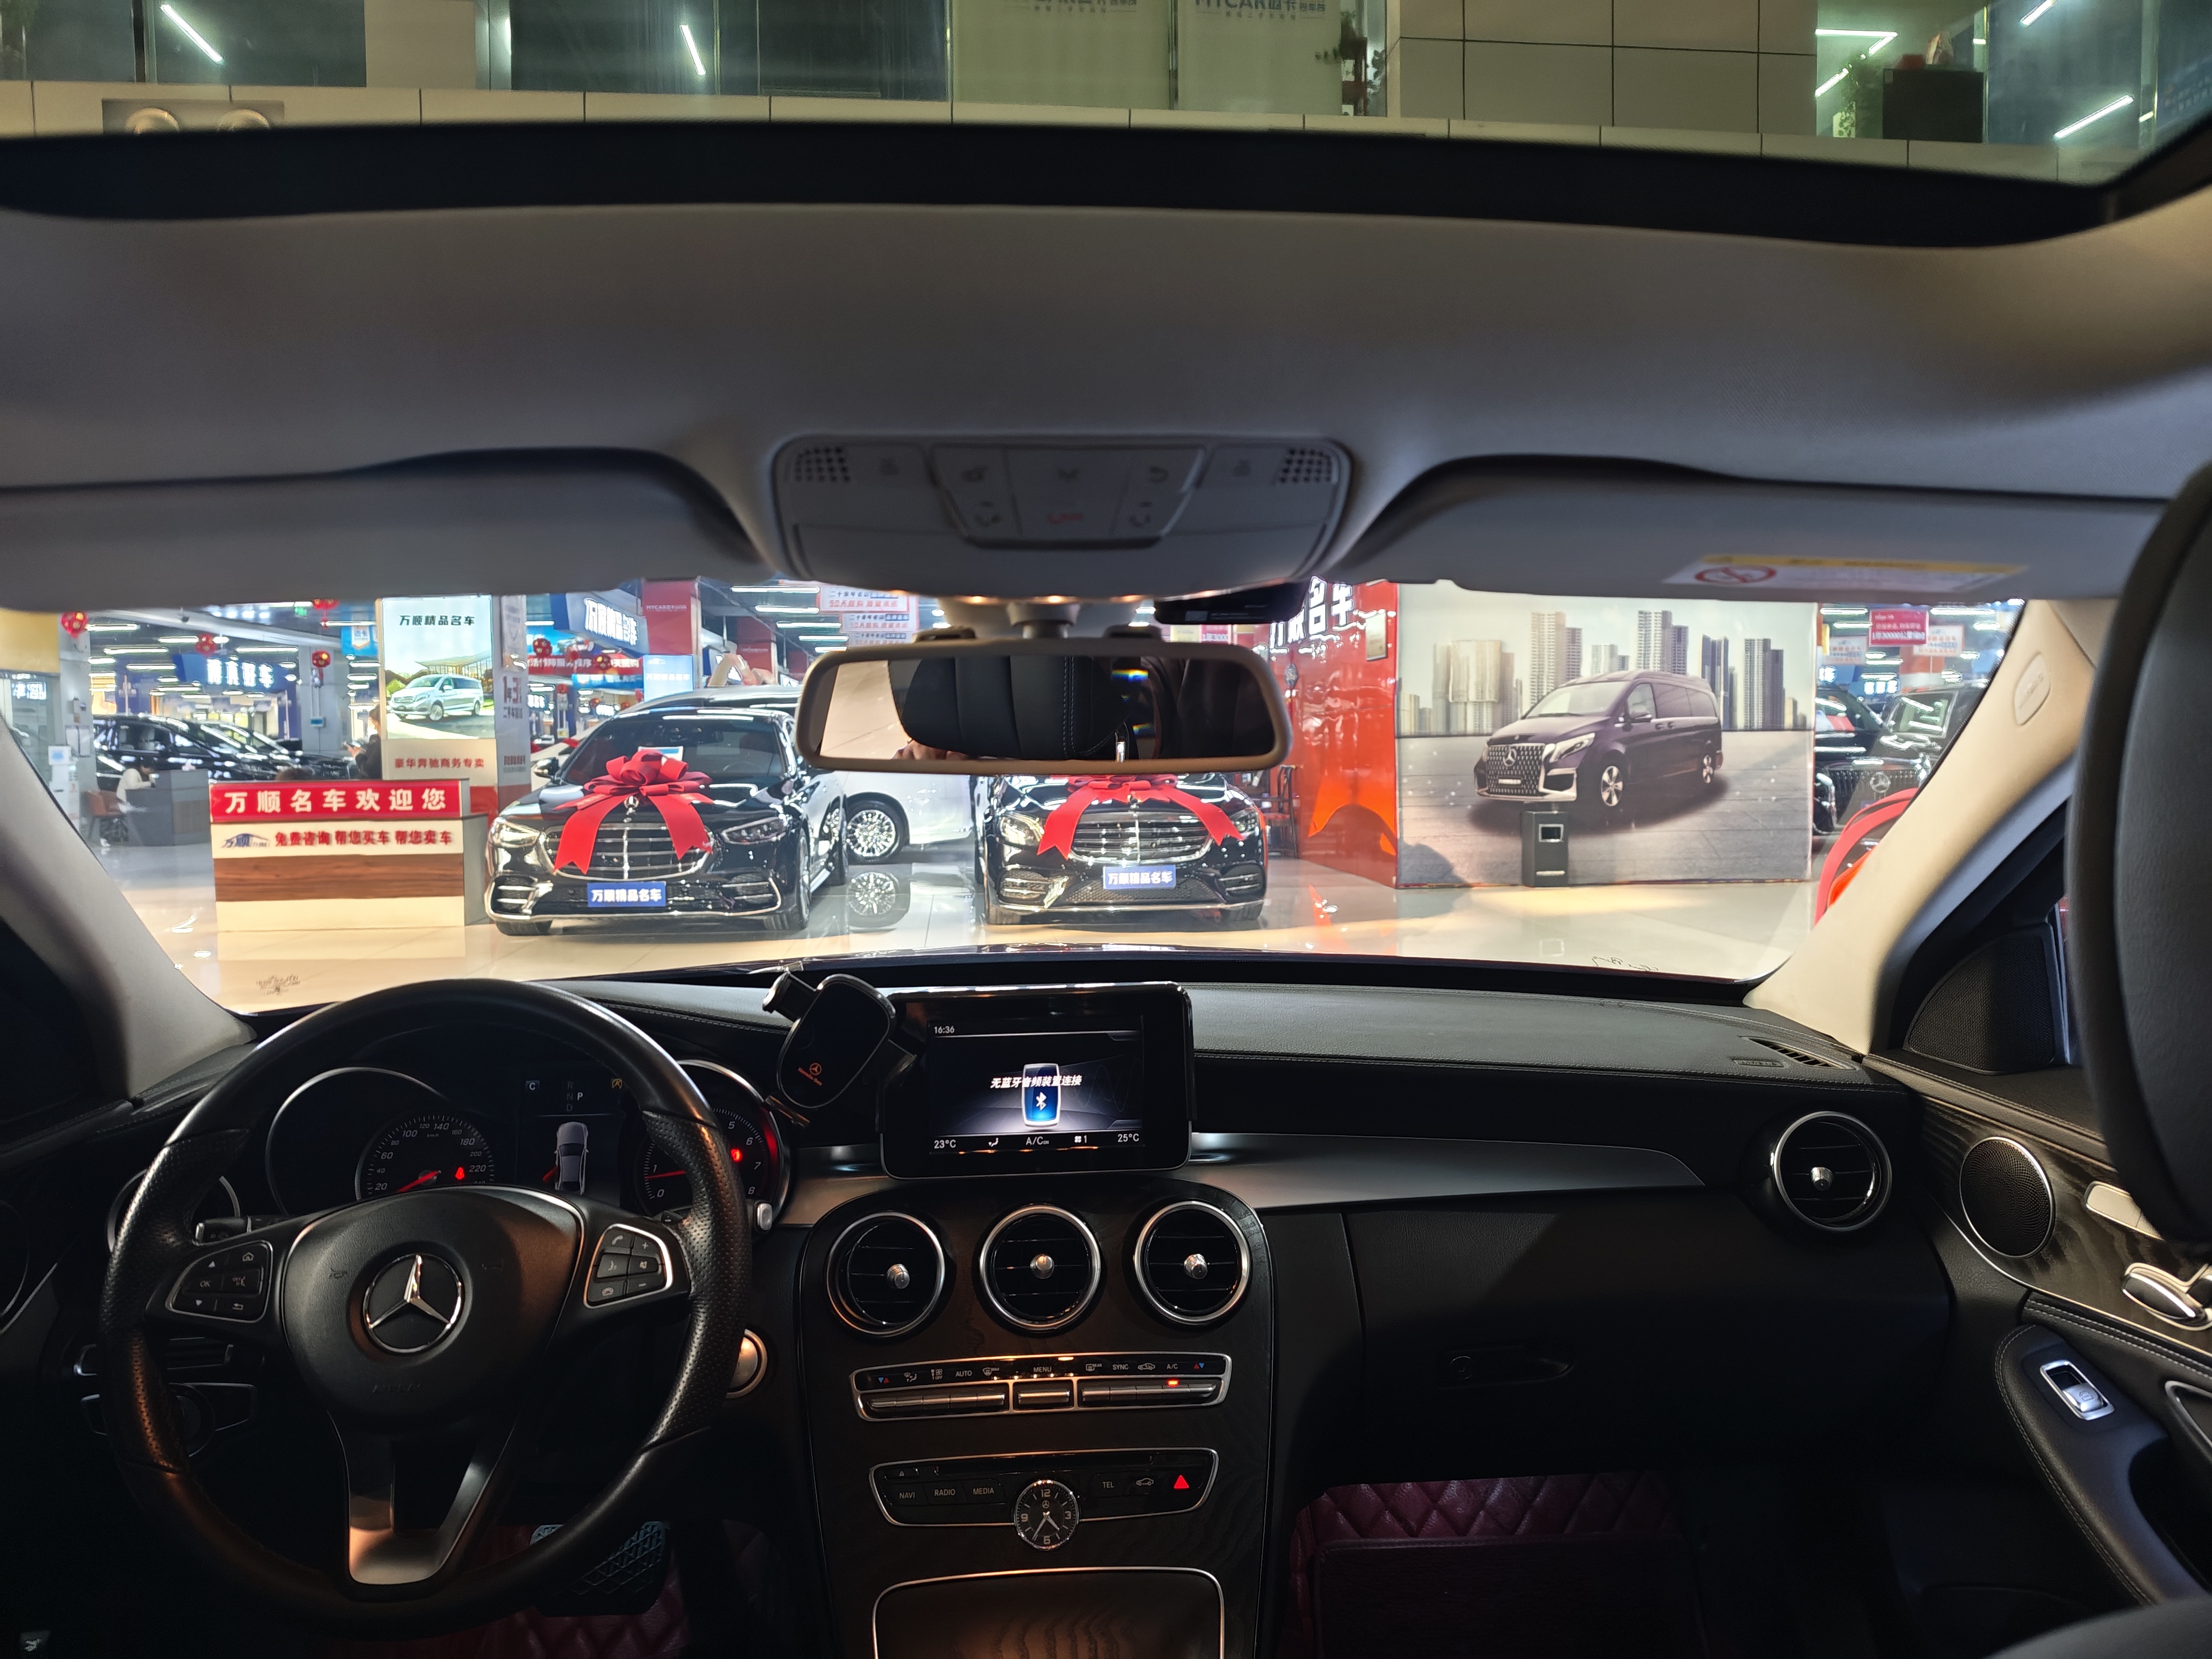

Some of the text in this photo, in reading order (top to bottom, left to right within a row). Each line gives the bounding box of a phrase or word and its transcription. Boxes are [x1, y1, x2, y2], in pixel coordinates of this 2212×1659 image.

[399, 615, 475, 626] 万顺精品名车
[224, 788, 446, 814] 万顺名车欢迎您
[275, 832, 331, 846] 免费咨询
[335, 831, 389, 846] 帮您买车
[395, 830, 453, 846] 帮您卖车
[934, 1026, 955, 1034] 16:36
[990, 1075, 1082, 1088] 无蓝牙音频装置连接
[529, 1082, 536, 1090] C
[577, 1092, 583, 1101] P
[728, 1121, 736, 1129] 5
[746, 1137, 753, 1145] 6
[381, 1151, 394, 1159] 60
[469, 1164, 486, 1172] 220
[653, 1164, 657, 1172] 1
[753, 1162, 761, 1170] 7
[657, 1189, 665, 1197] 0
[747, 1186, 756, 1195] 8
[955, 1370, 973, 1378] AUTO
[1041, 1488, 1051, 1498] 12
[1021, 1513, 1028, 1522] 9
[1064, 1510, 1071, 1520] 3
[1043, 1535, 1051, 1545] 6
